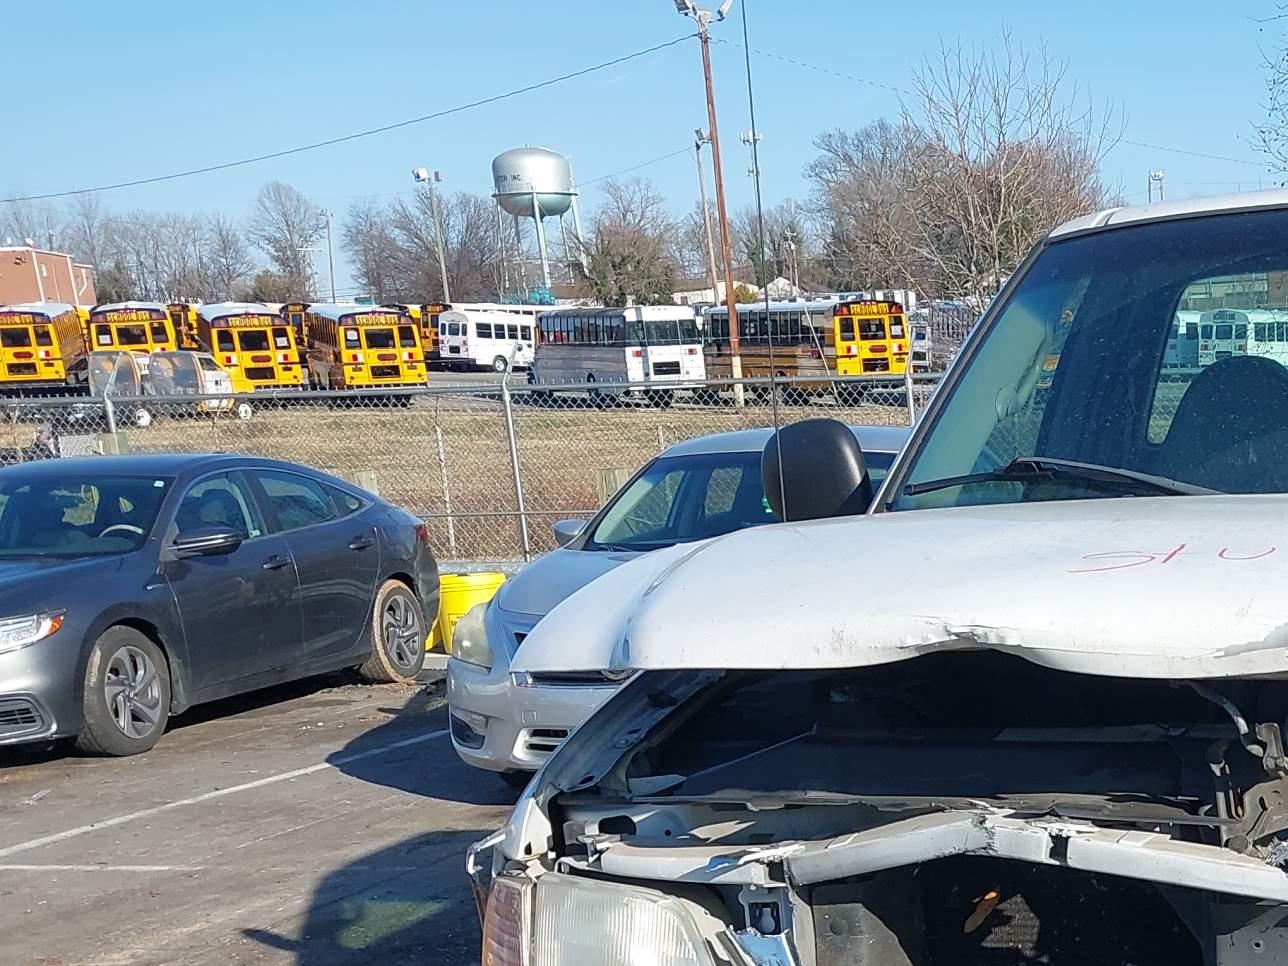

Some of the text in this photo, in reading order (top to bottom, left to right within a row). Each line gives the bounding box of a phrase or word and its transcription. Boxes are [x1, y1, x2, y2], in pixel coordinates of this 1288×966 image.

[852, 303, 889, 315] SCHOOL BUS
[107, 311, 149, 322] SCHOOL BUS
[229, 316, 271, 327] SCHOOL BUS
[356, 315, 398, 326] SCHOOL BUS
